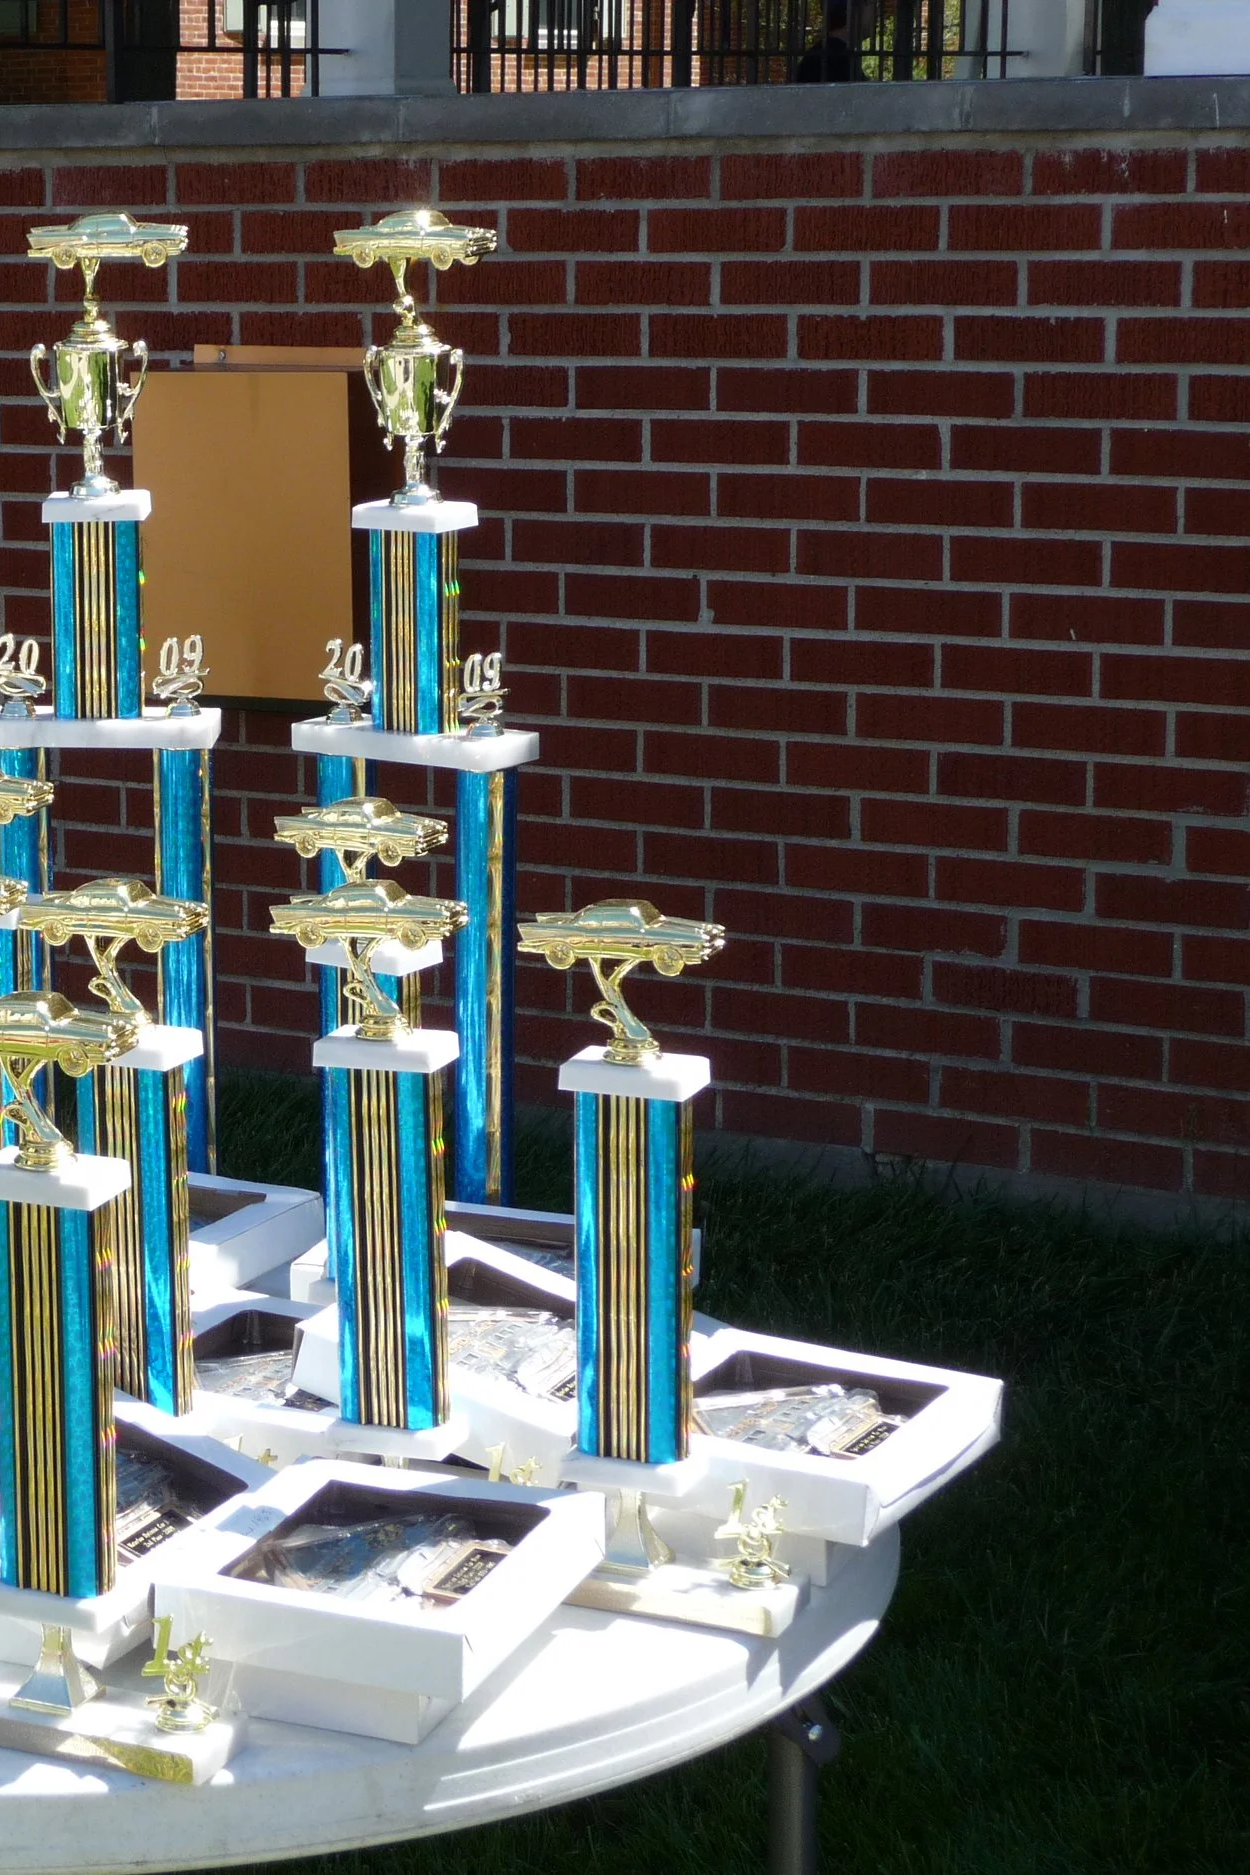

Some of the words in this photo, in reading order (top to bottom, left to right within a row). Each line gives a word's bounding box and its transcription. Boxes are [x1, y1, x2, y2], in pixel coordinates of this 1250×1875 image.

[159, 634, 203, 675] 09
[319, 638, 363, 681] 20
[463, 652, 502, 692] 09
